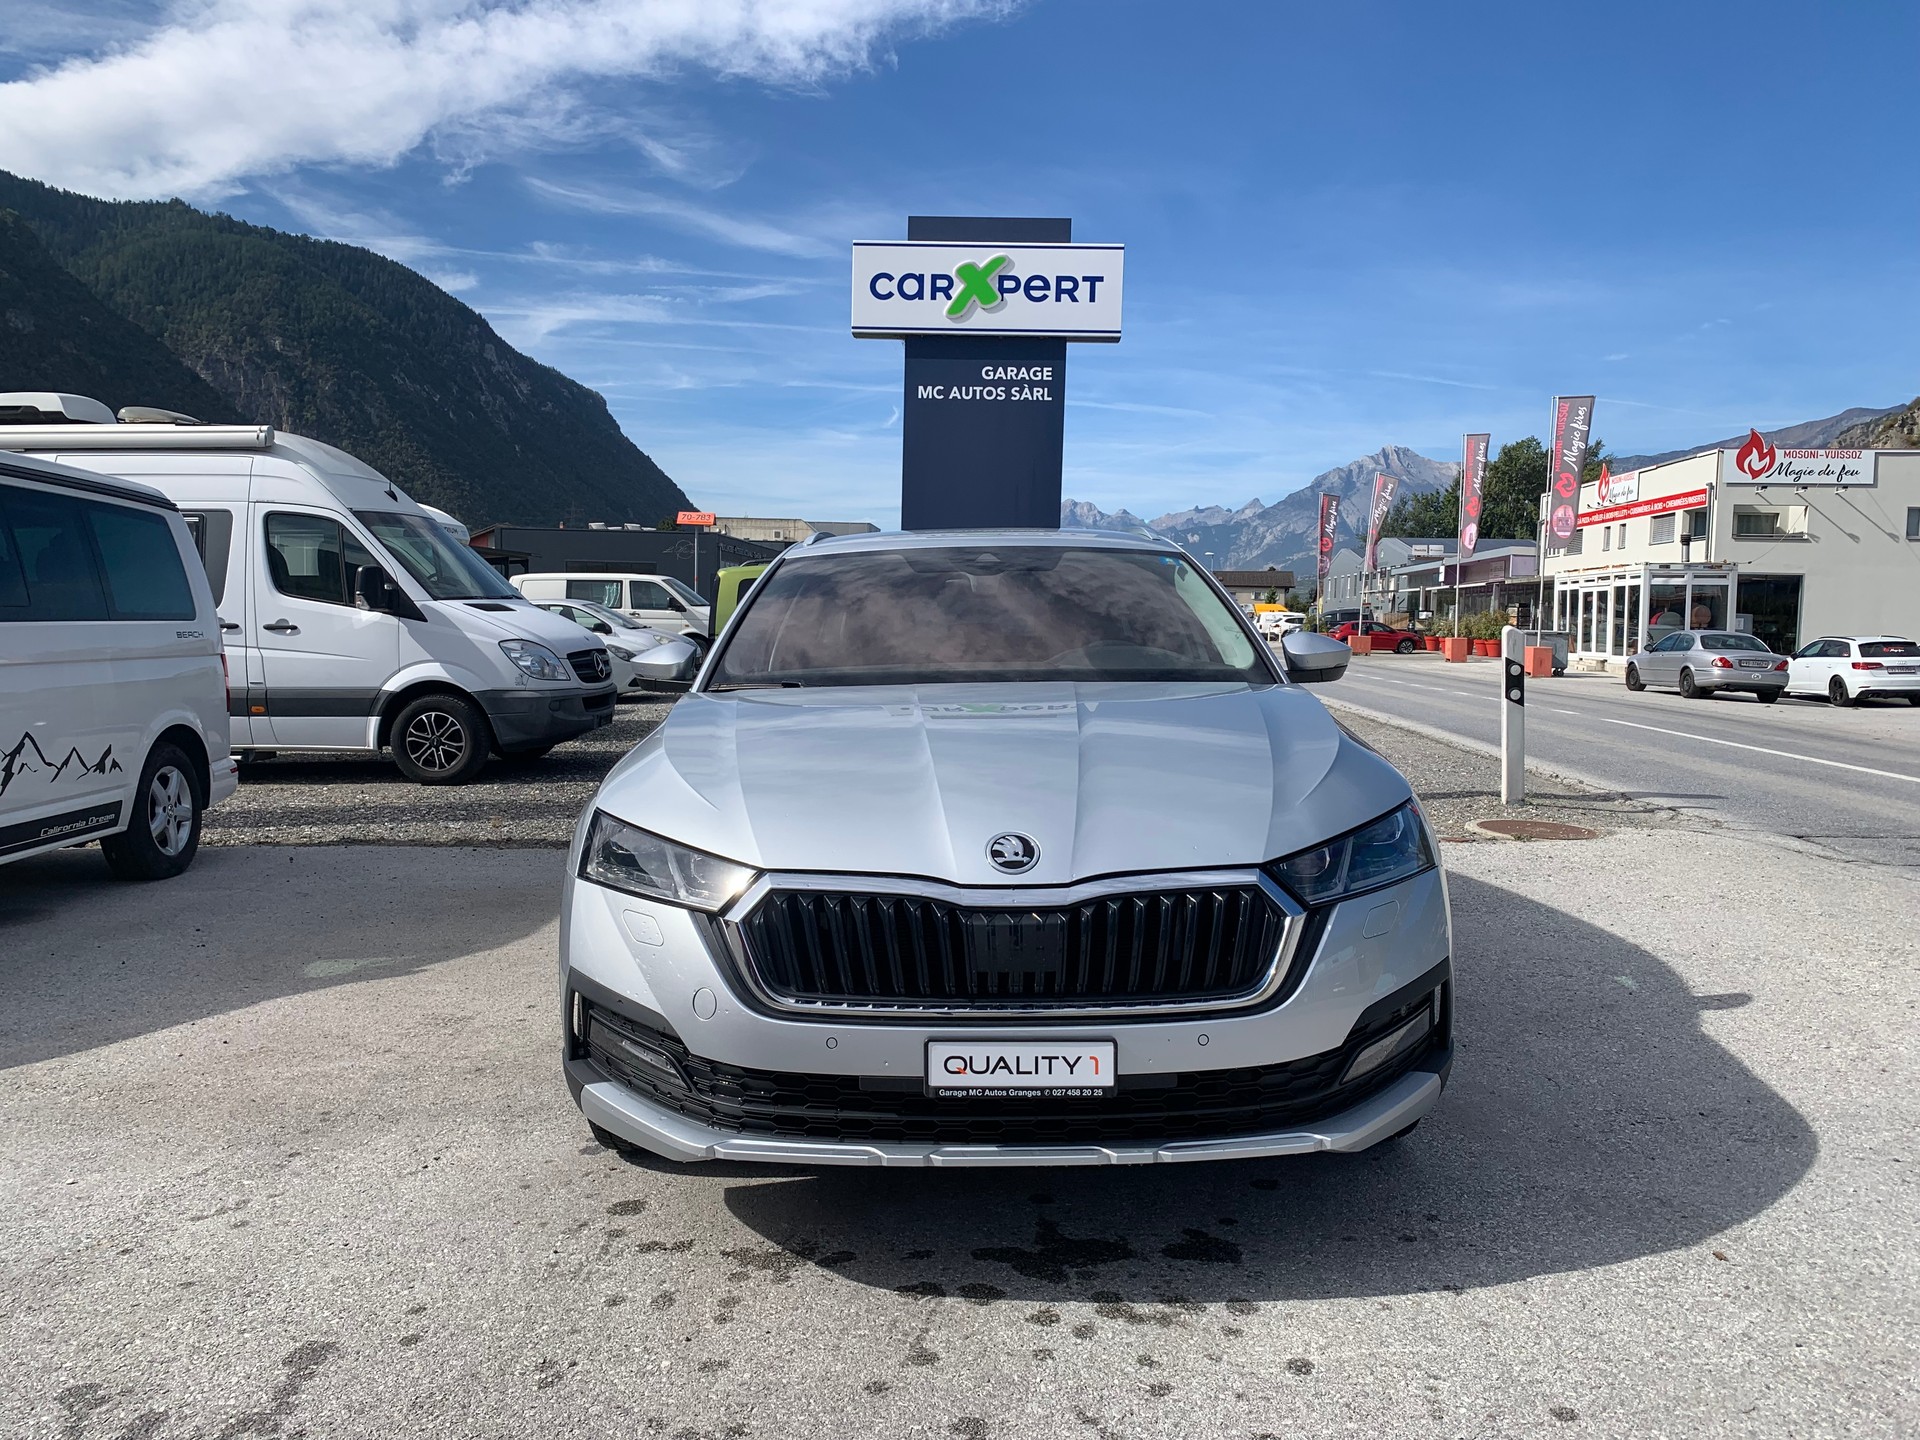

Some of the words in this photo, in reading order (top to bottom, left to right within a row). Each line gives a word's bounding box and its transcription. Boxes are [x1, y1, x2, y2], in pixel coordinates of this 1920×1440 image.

[981, 366, 1053, 381] GARAGE
[918, 386, 944, 400] MC
[949, 386, 1005, 401] AUTOS
[1011, 384, 1053, 401] SÀRL
[1570, 406, 1589, 431] fires
[1563, 431, 1585, 472] Magic
[1783, 450, 1862, 460] MOSONI-VUISSOZ
[1765, 461, 1816, 482] Magie
[1818, 464, 1837, 476] du
[1836, 464, 1861, 482] feu
[681, 513, 711, 521] 70-783
[176, 631, 204, 639] BEACH
[40, 820, 86, 837] California
[88, 813, 115, 825] Dream
[943, 1055, 1082, 1075] QUALITY
[1089, 1056, 1099, 1075] 1
[939, 1089, 967, 1098] Garage
[1009, 1089, 1041, 1098] Granges
